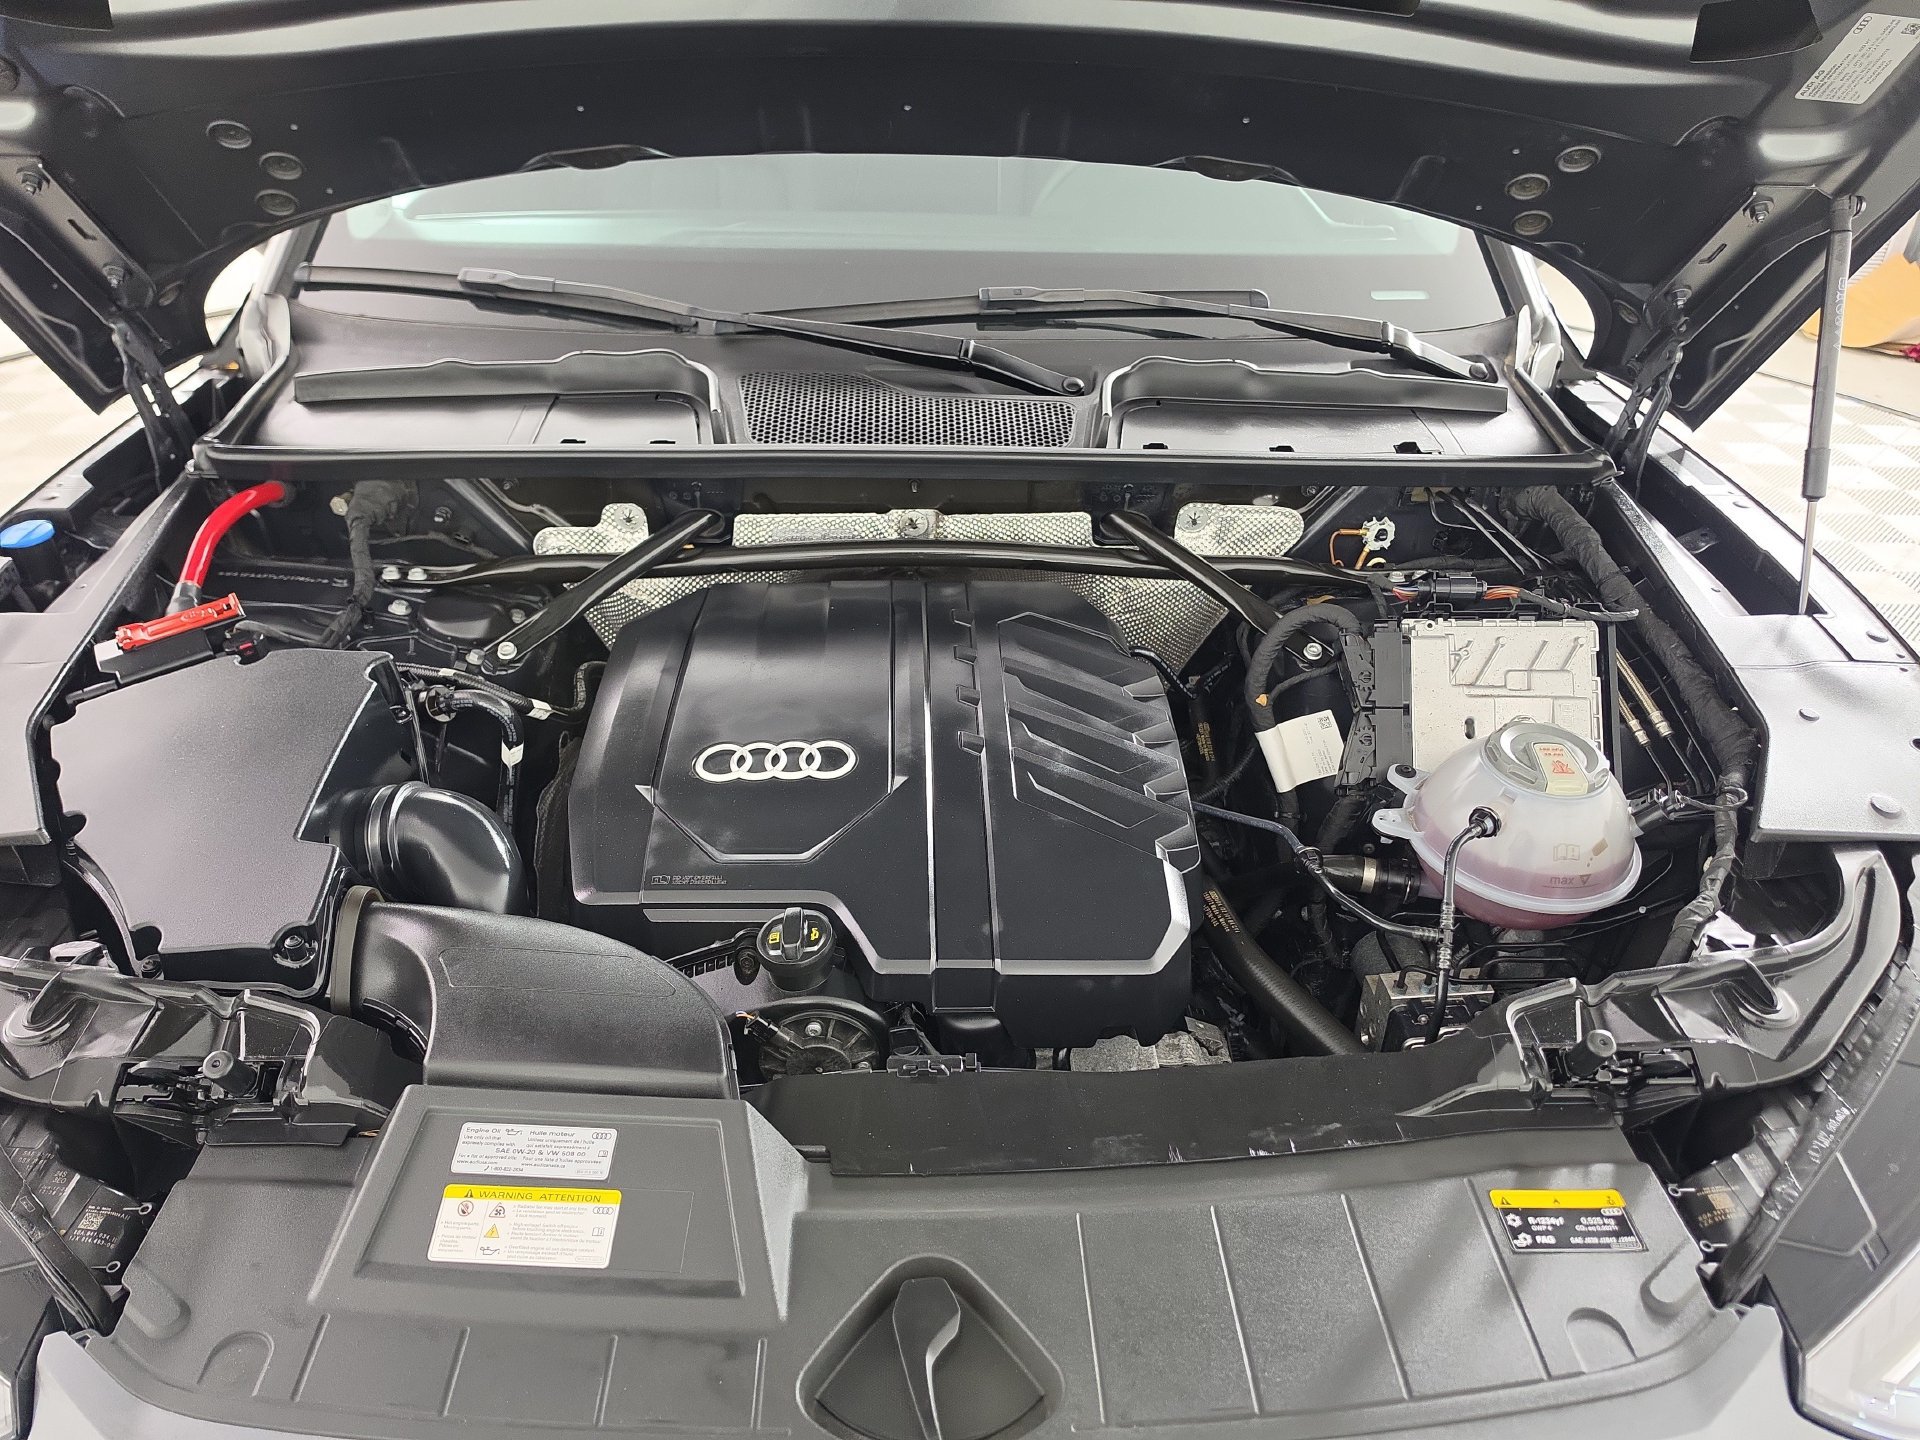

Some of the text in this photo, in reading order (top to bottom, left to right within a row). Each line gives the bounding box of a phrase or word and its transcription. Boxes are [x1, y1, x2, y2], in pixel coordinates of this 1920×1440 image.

[1800, 69, 1825, 96] AUDI AG
[1550, 875, 1575, 885] max
[480, 1191, 601, 1202] WARNING ATTENTION
[1603, 1217, 1615, 1225] kg
[1535, 1235, 1556, 1244] PAG
